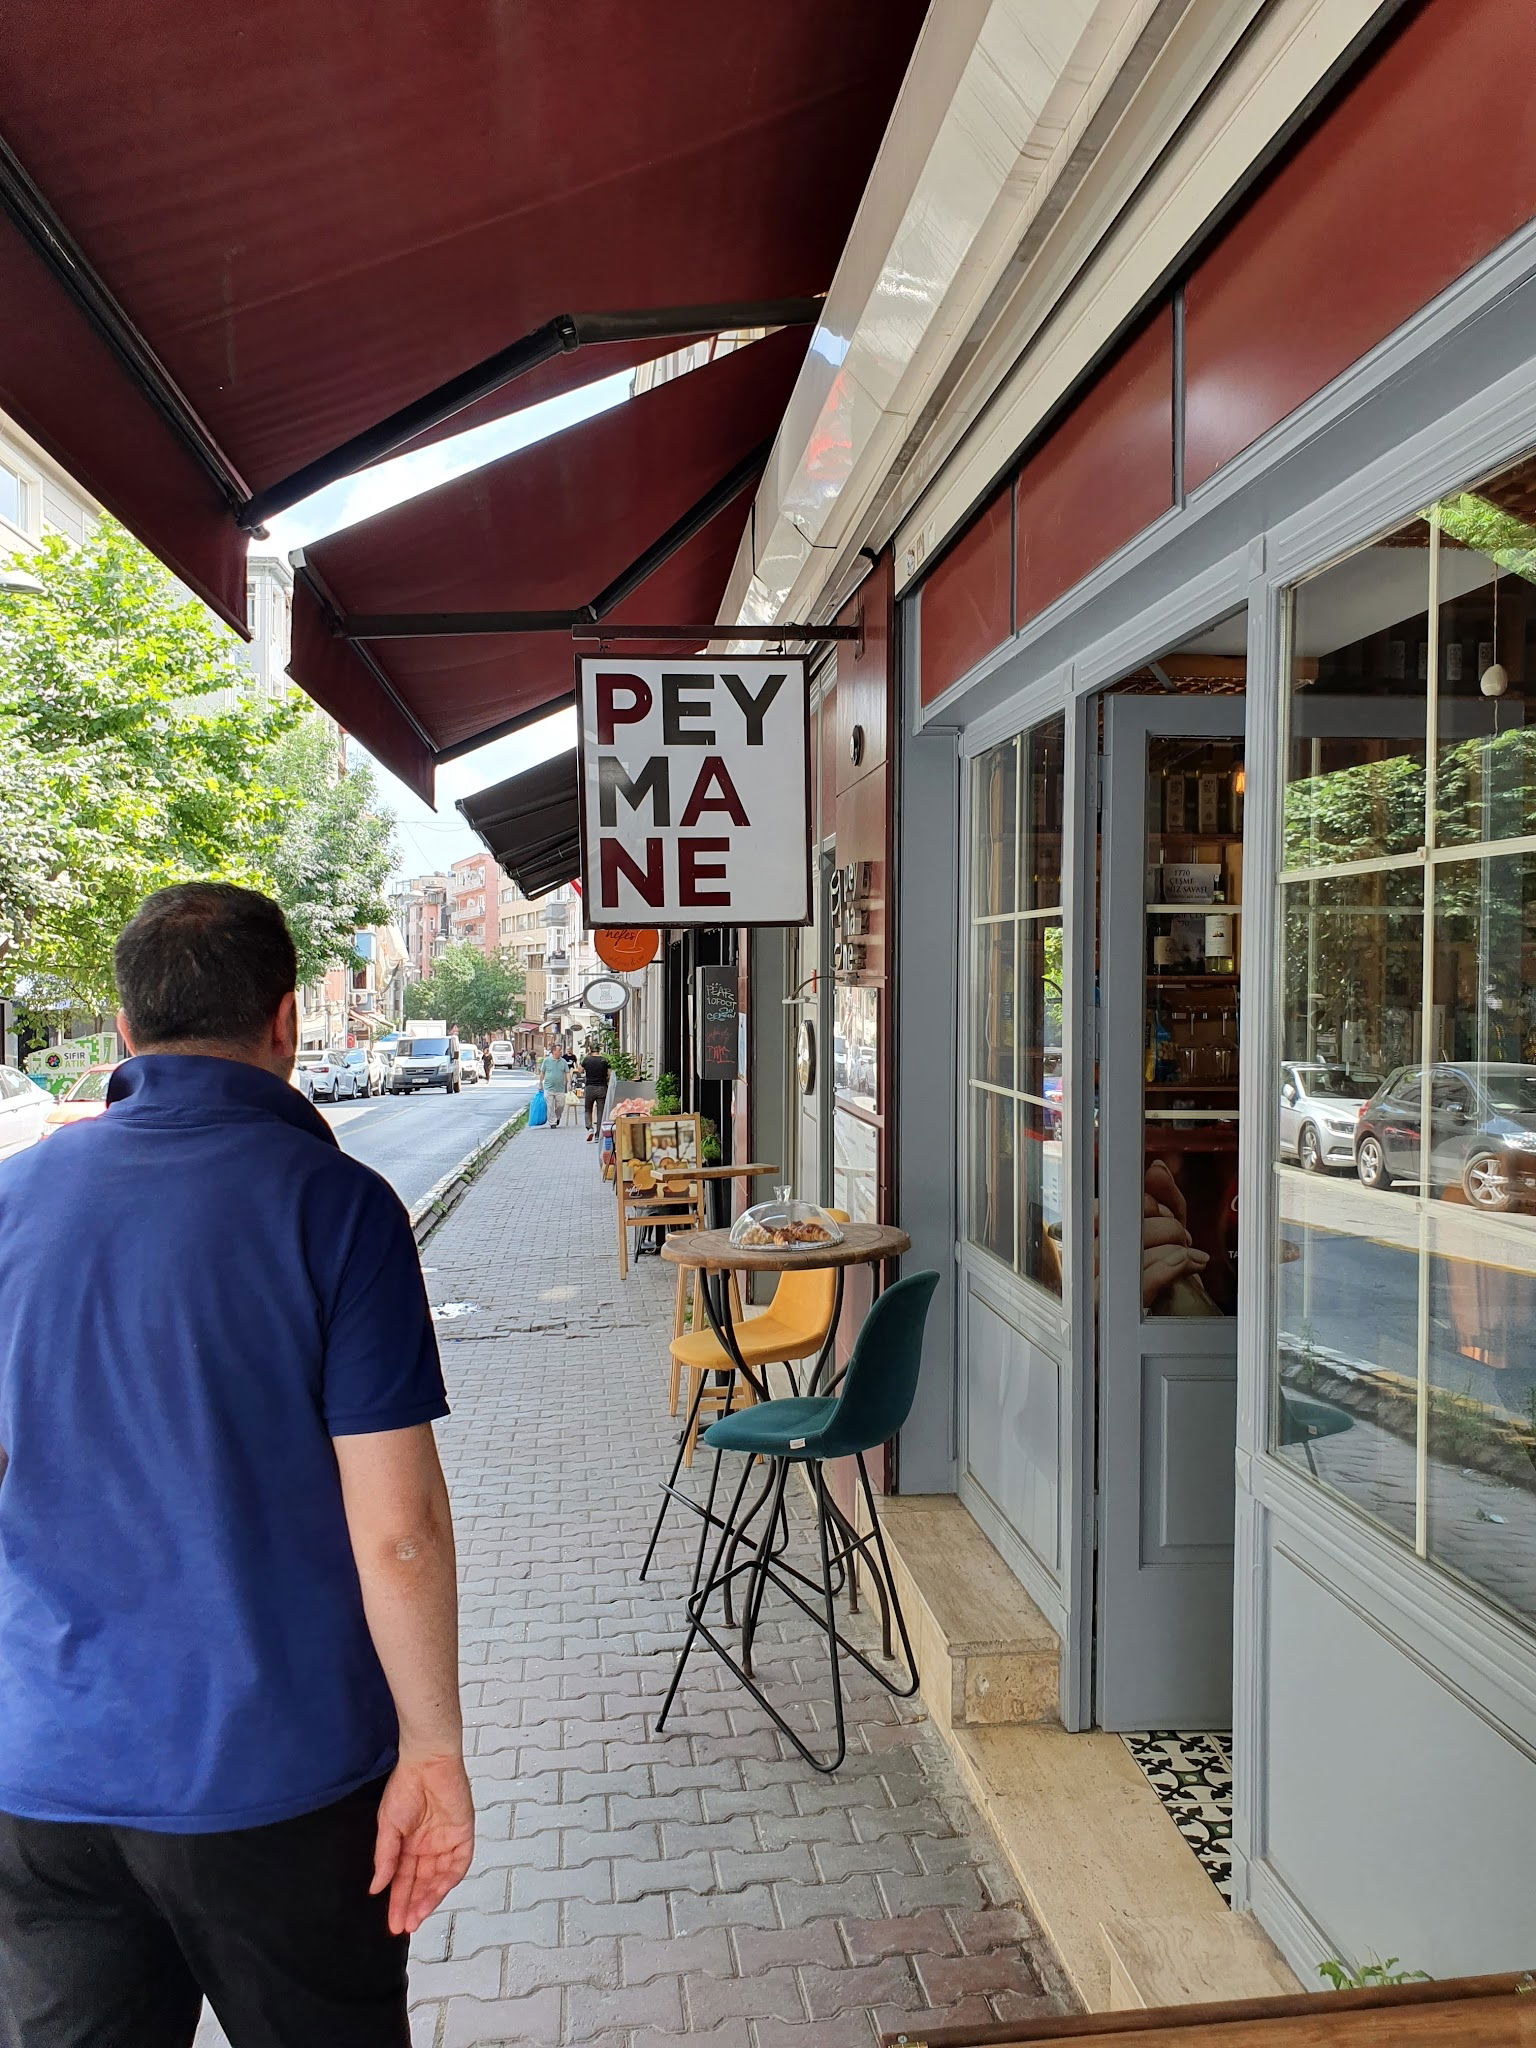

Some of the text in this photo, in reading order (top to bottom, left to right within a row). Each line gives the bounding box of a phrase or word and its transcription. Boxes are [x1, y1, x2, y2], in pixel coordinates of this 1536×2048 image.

[595, 673, 788, 746] PEY
[597, 755, 752, 828] MA
[599, 837, 732, 908] NE
[63, 1052, 86, 1060] SIFIR
